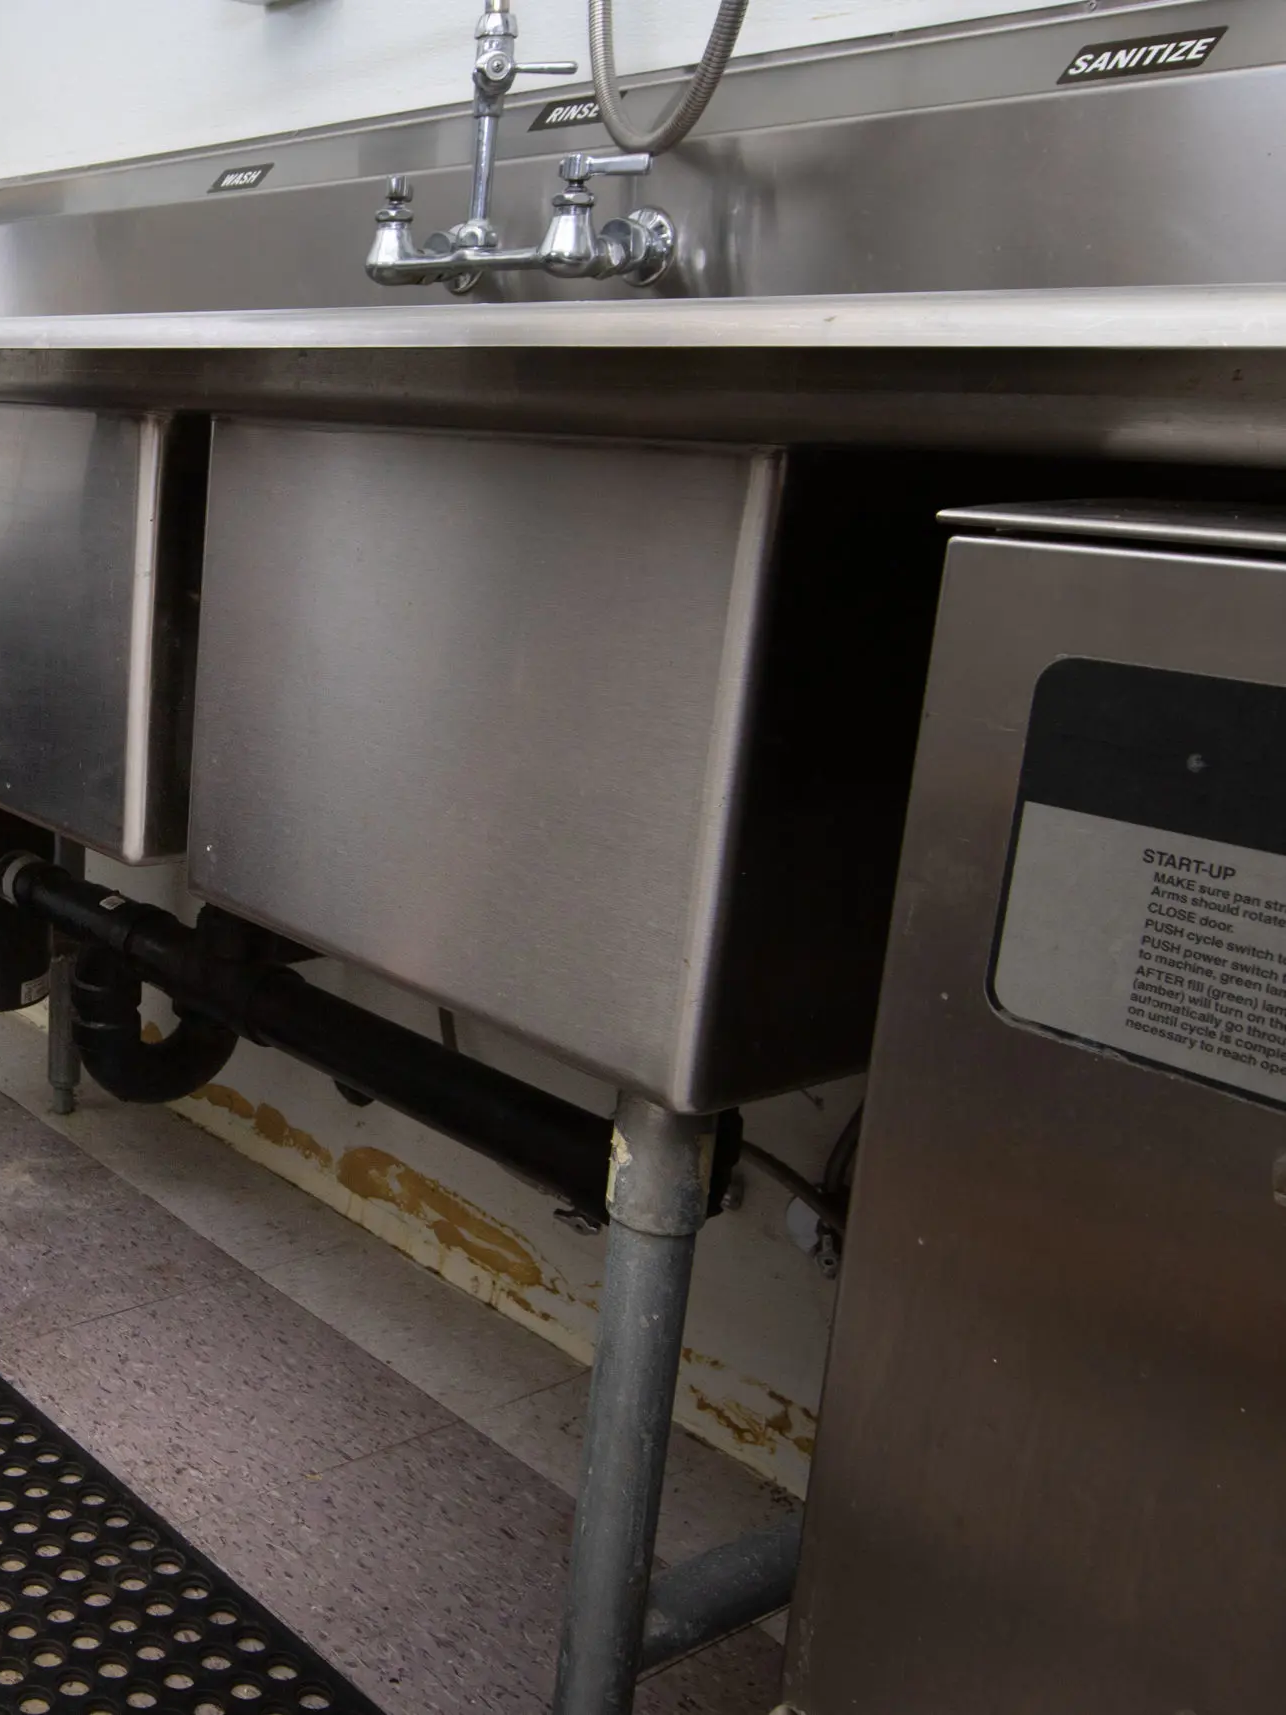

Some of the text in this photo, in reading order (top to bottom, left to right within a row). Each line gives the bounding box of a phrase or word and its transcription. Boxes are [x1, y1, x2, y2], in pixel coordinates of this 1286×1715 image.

[1068, 37, 1217, 75] SANITIZE
[220, 169, 262, 187] WASH
[1142, 848, 1237, 881] START-UP
[1151, 885, 1188, 904] Arms
[1191, 896, 1240, 917] should
[1153, 871, 1197, 892] MAKE
[1198, 884, 1230, 899] sure
[1233, 893, 1261, 907] pan
[1147, 902, 1235, 934] CLOSE door.
[1141, 935, 1181, 954] PUSH
[1183, 948, 1229, 967] power
[1230, 960, 1279, 981] switch
[1144, 918, 1185, 938] PUSH
[1186, 930, 1224, 949] cycle
[1226, 941, 1274, 961] switch
[1135, 965, 1185, 988] AFTER
[1187, 979, 1204, 993] fill
[1206, 985, 1259, 1011] (green)
[1138, 949, 1152, 961] to
[1154, 953, 1217, 980] machine,
[1220, 972, 1262, 992] green
[1130, 992, 1223, 1029] automatically
[1225, 1020, 1244, 1033] go
[1132, 978, 1186, 1004] (amber)
[1188, 994, 1212, 1009] will
[1214, 1002, 1244, 1019] turn
[1247, 1012, 1266, 1025] on
[1125, 1018, 1199, 1049] necessary
[1200, 1040, 1214, 1053] to
[1216, 1046, 1257, 1066] reach
[1127, 1005, 1145, 1018] on
[1147, 1011, 1178, 1027] until
[1180, 1020, 1217, 1039] cycle
[1218, 1031, 1232, 1044] is
